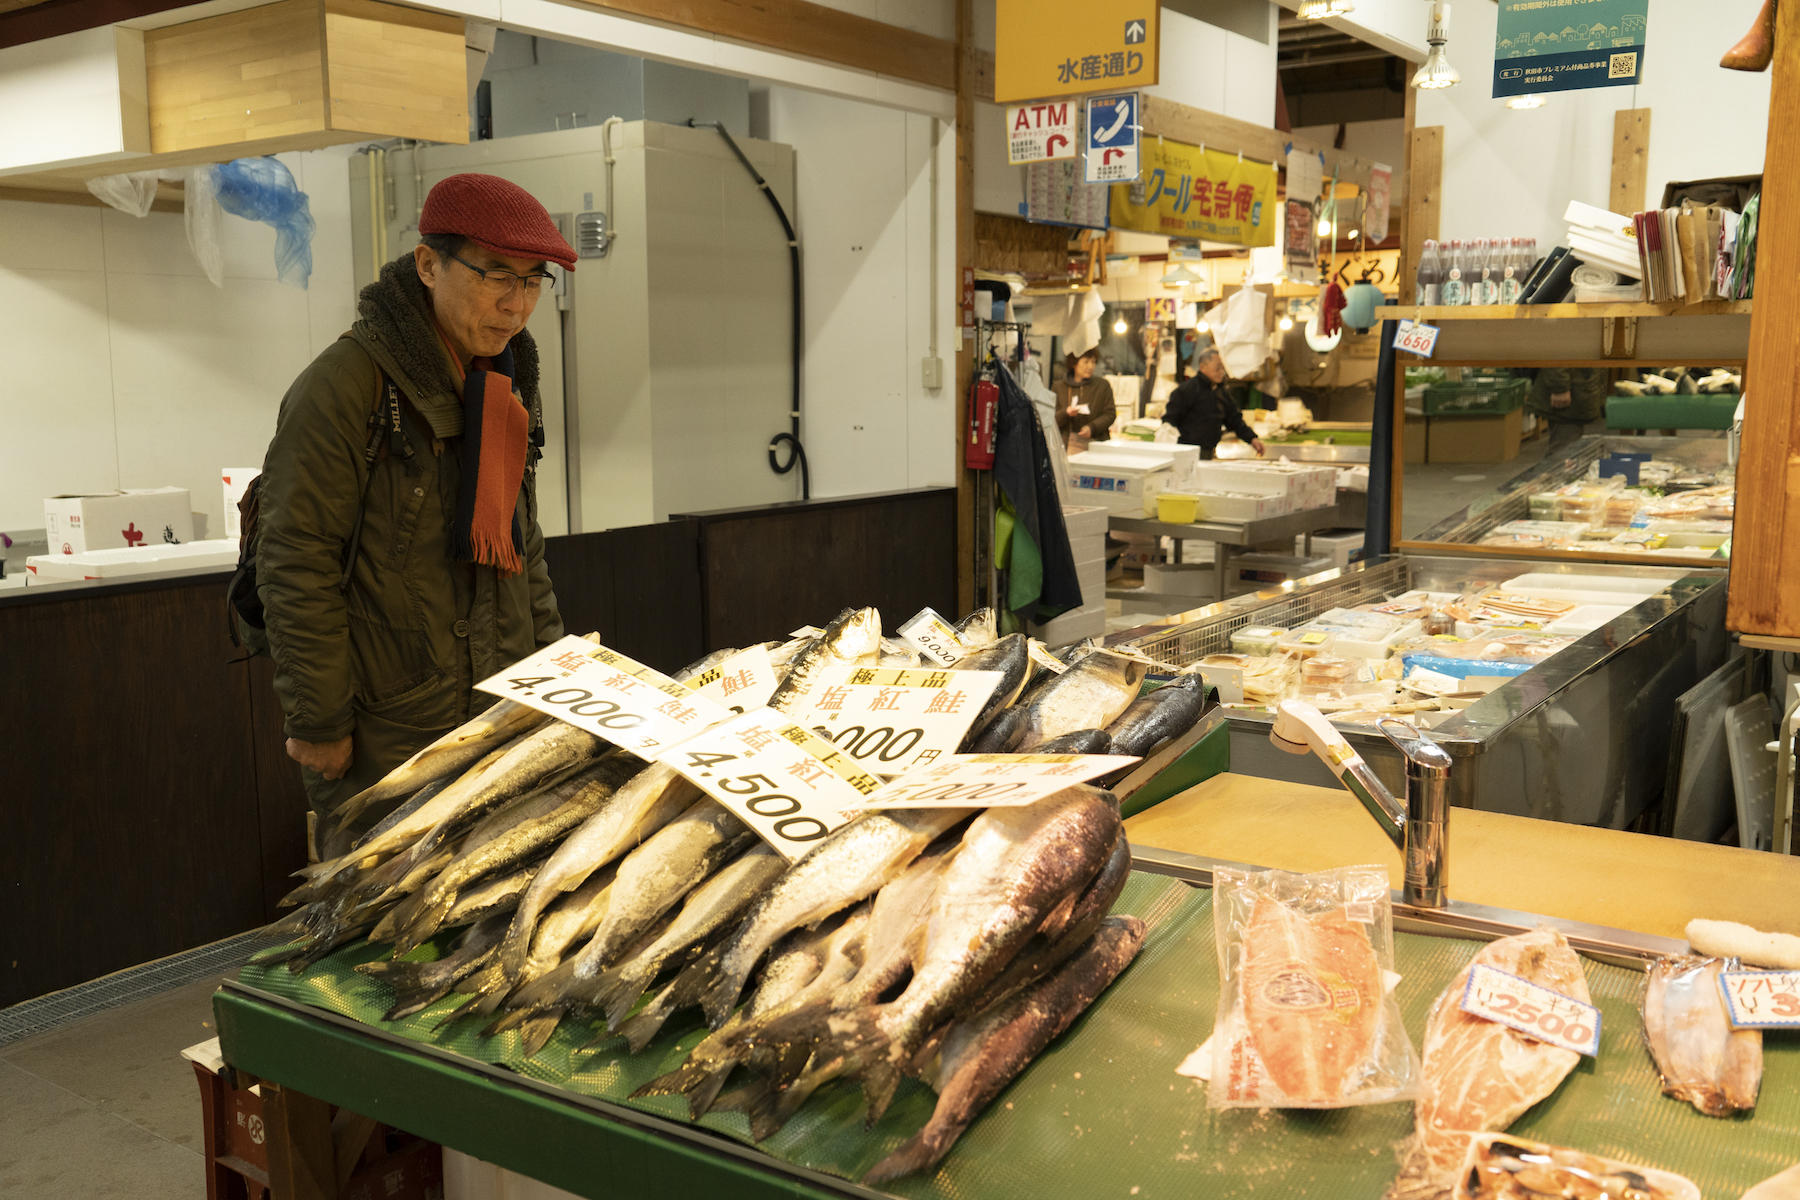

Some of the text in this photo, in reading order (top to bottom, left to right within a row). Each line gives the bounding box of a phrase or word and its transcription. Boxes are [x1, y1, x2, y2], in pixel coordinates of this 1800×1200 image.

[1057, 50, 1144, 84] 水産通り
[1015, 103, 1068, 131] ATM
[1147, 167, 1254, 222] クール宅急便
[550, 651, 698, 724] 塩紅鮭
[591, 649, 687, 699] 極上品
[699, 668, 720, 687] 品
[721, 669, 757, 697] 鮭
[851, 668, 947, 688] 極上品
[815, 685, 968, 714] 塩紅鮭
[779, 726, 878, 796] 極上品
[911, 749, 943, 766] 円
